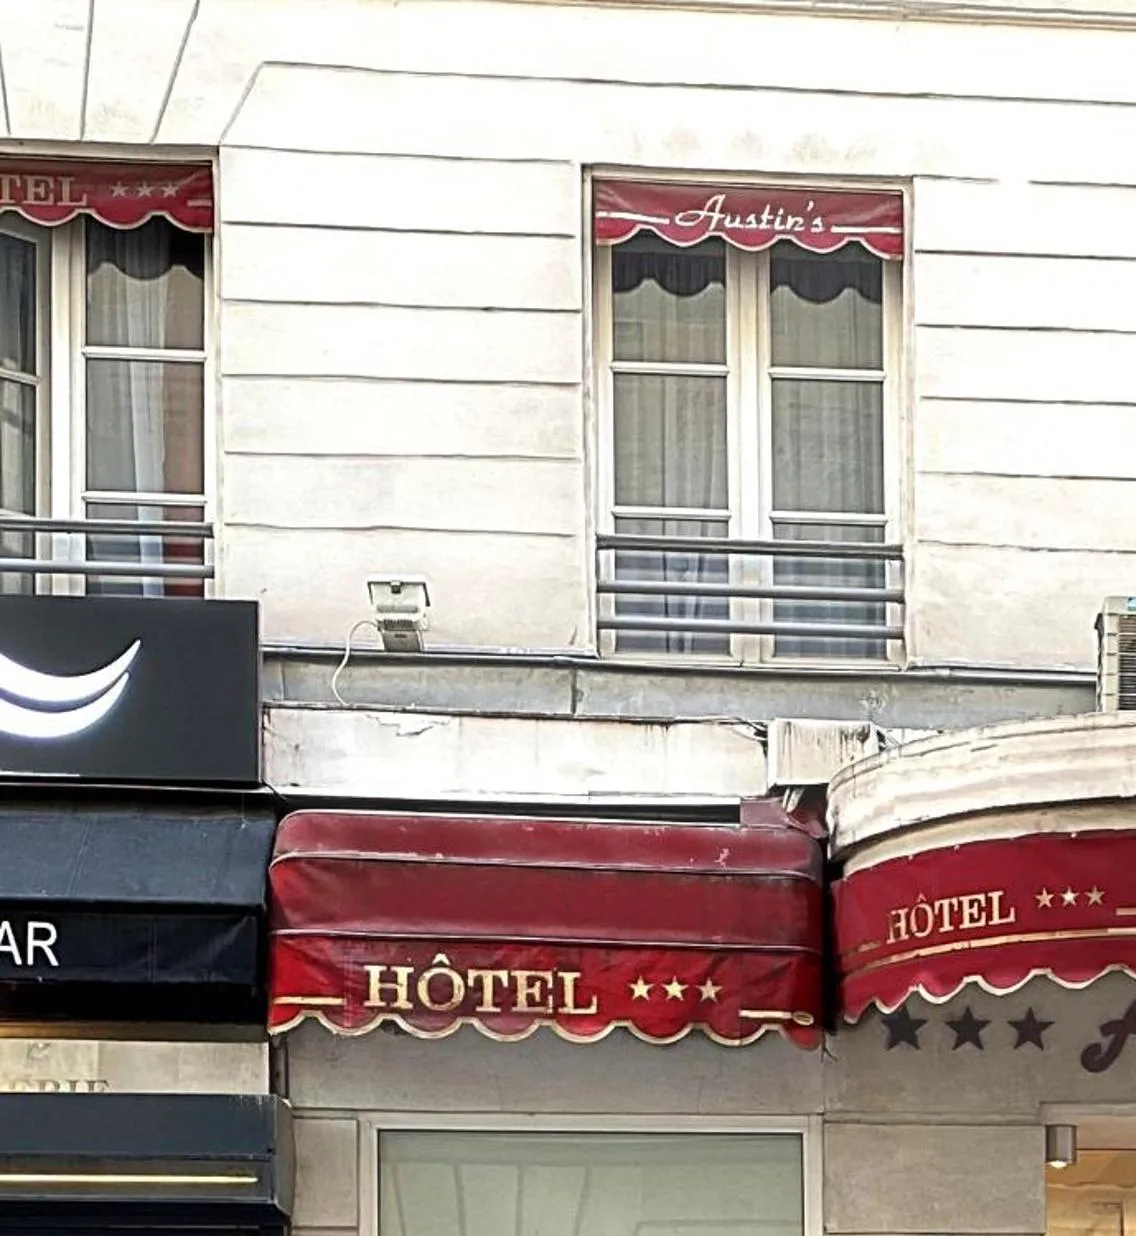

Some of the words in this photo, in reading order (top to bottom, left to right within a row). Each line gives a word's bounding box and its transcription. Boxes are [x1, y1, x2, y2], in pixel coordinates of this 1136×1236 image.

[0, 174, 87, 206] TEL
[675, 194, 825, 232] Austin's
[886, 892, 1016, 944] HÔTEL
[0, 920, 59, 966] AR
[364, 953, 598, 1014] HÔTEL
